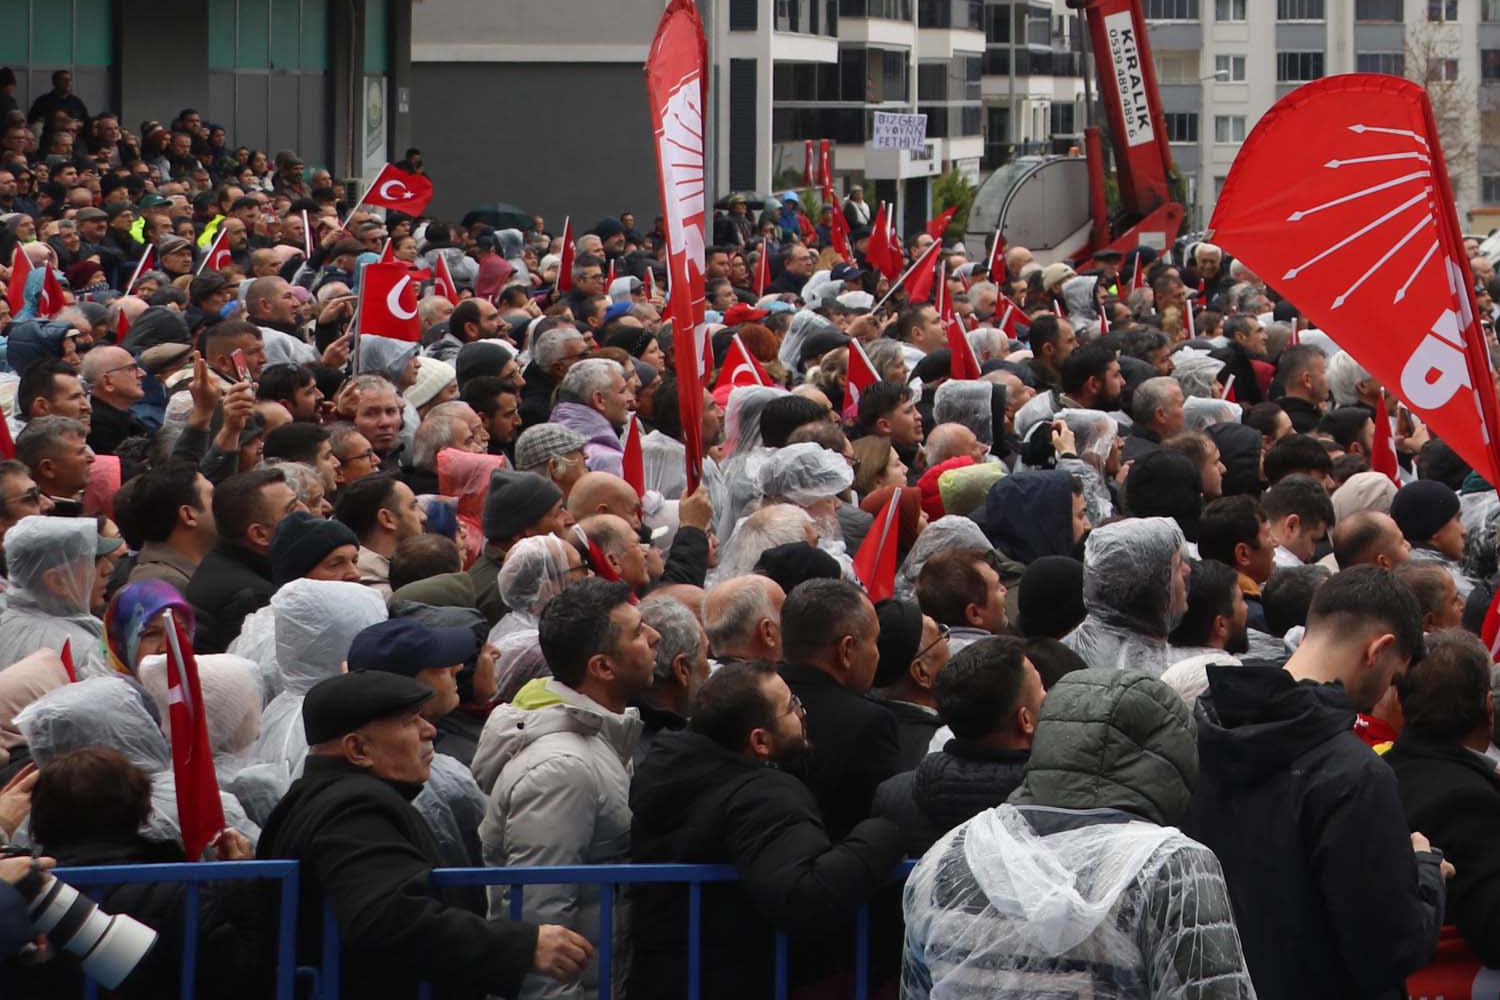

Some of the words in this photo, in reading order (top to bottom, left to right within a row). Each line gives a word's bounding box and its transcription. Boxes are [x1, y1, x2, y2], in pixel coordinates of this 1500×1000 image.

[1109, 29, 1123, 64] 0539
[1117, 69, 1129, 95] 489
[1123, 99, 1135, 125] 489
[1128, 129, 1137, 138] 6
